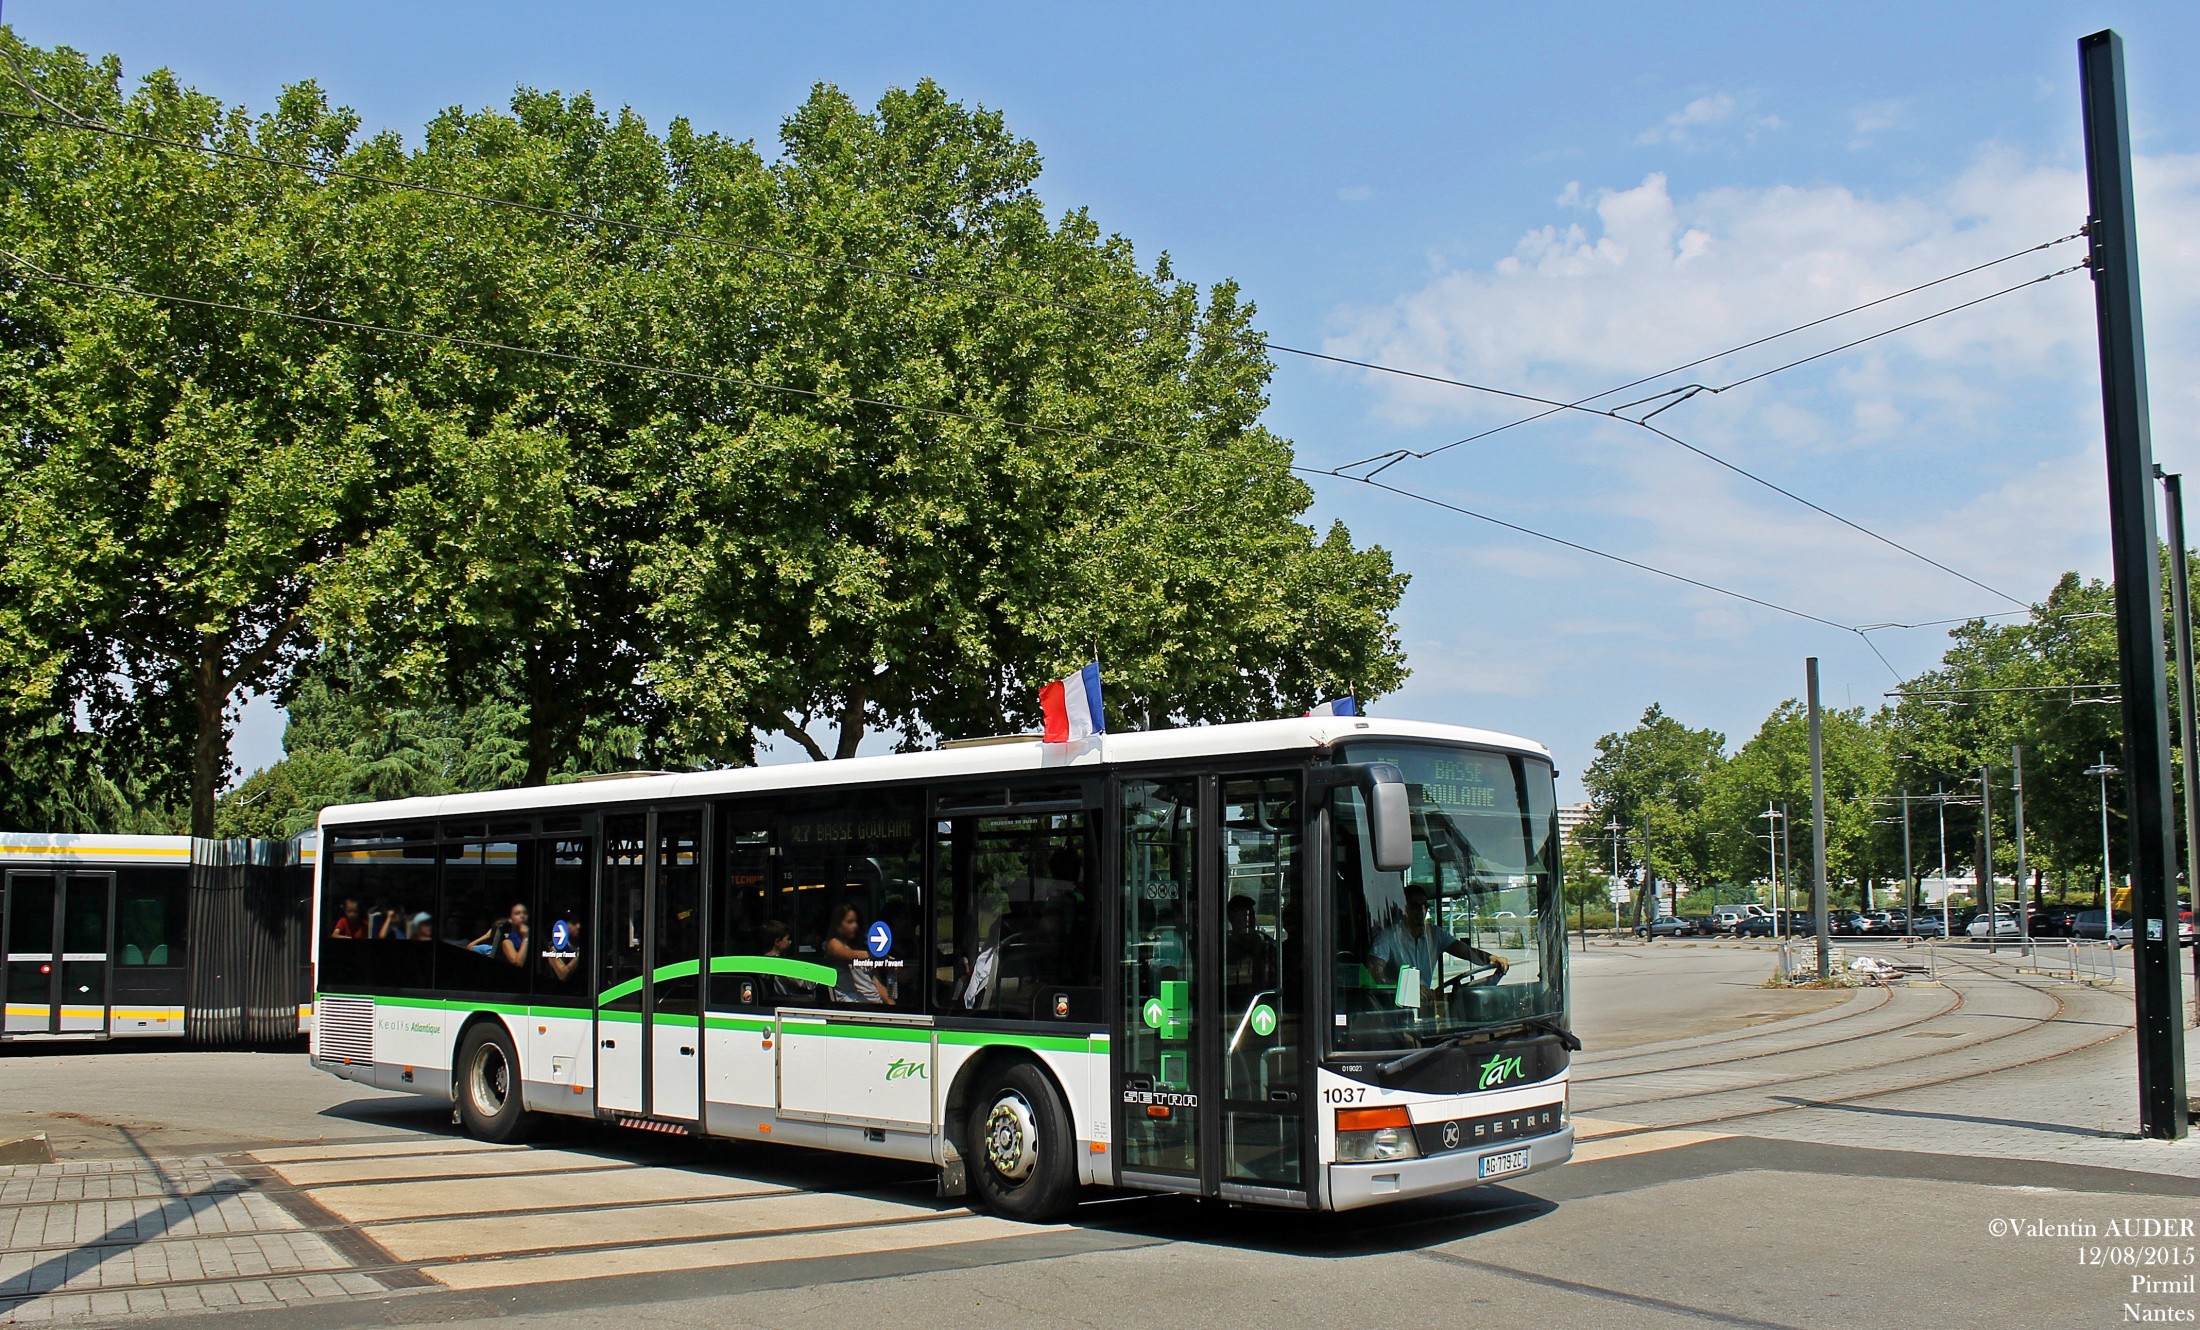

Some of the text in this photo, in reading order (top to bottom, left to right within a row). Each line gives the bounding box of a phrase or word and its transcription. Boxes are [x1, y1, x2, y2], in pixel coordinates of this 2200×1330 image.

[1435, 760, 1483, 782] BASSE
[816, 823, 853, 841] BASSE
[378, 1018, 441, 1036] Keolis Atlantique
[885, 1057, 929, 1081] tan
[1478, 1053, 1526, 1090] tan
[1123, 1090, 1198, 1107] SETRA
[1323, 1088, 1366, 1104] 1037
[1475, 1112, 1551, 1137] SETRA
